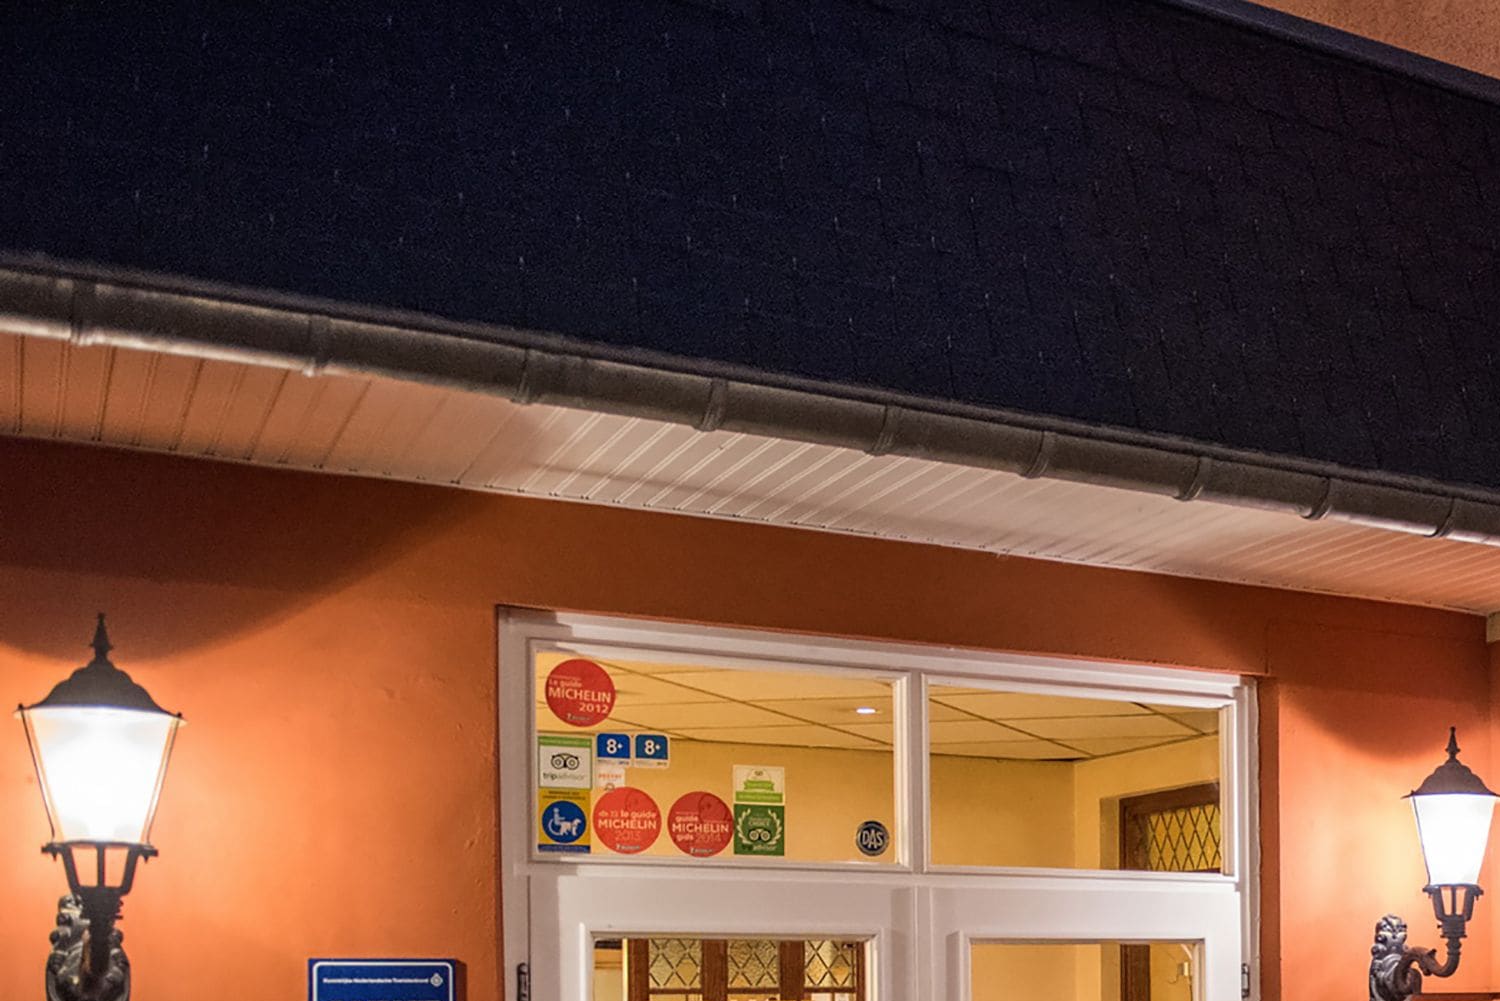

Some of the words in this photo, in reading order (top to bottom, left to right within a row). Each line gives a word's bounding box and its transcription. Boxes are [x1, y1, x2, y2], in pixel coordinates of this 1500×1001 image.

[548, 687, 612, 703] MICHELIN
[579, 702, 609, 713] 2012
[597, 819, 657, 829] MICHELIN
[671, 822, 729, 833] MICHELIN
